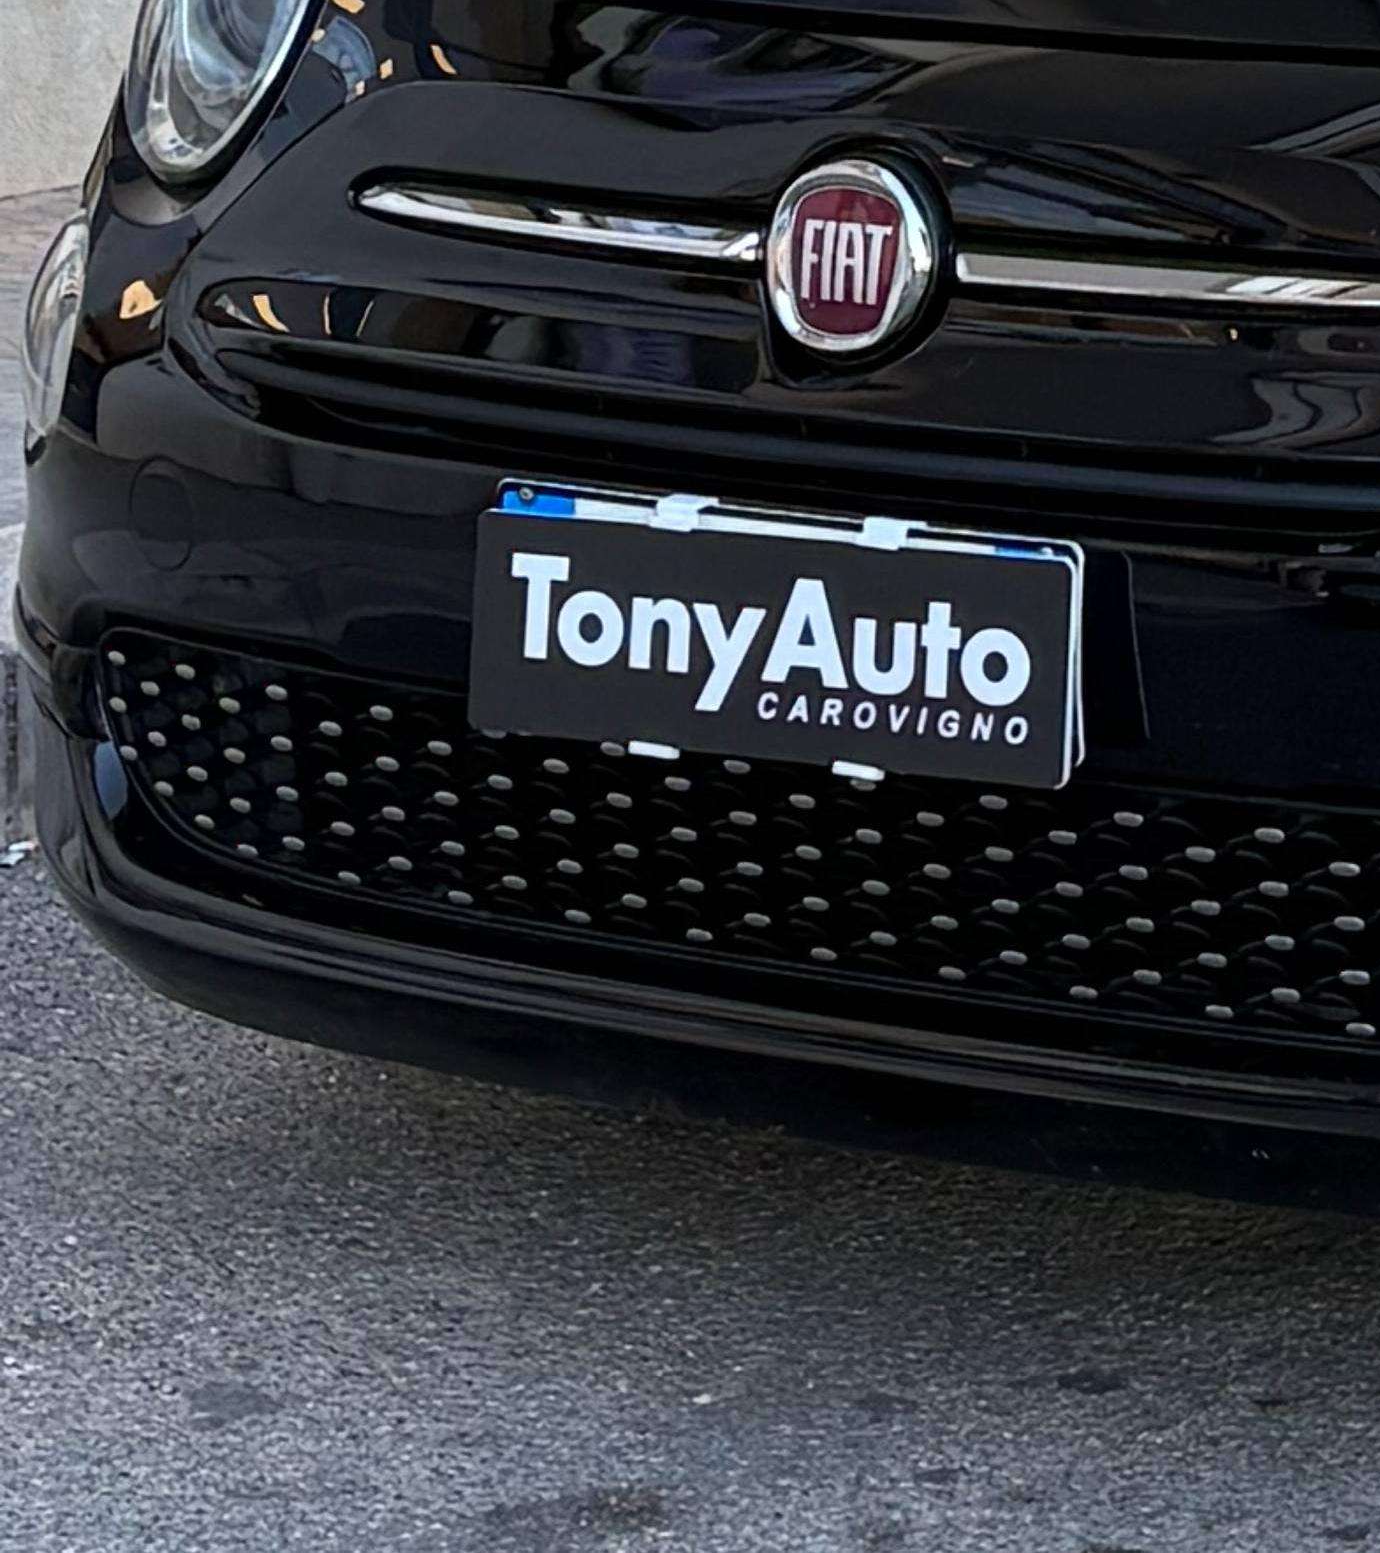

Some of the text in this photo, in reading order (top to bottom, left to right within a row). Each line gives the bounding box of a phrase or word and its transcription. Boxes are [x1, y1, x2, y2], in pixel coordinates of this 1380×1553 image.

[801, 218, 893, 306] FIAT
[511, 552, 1032, 712] TonyAuto
[757, 691, 1031, 745] CAROVIGNO
